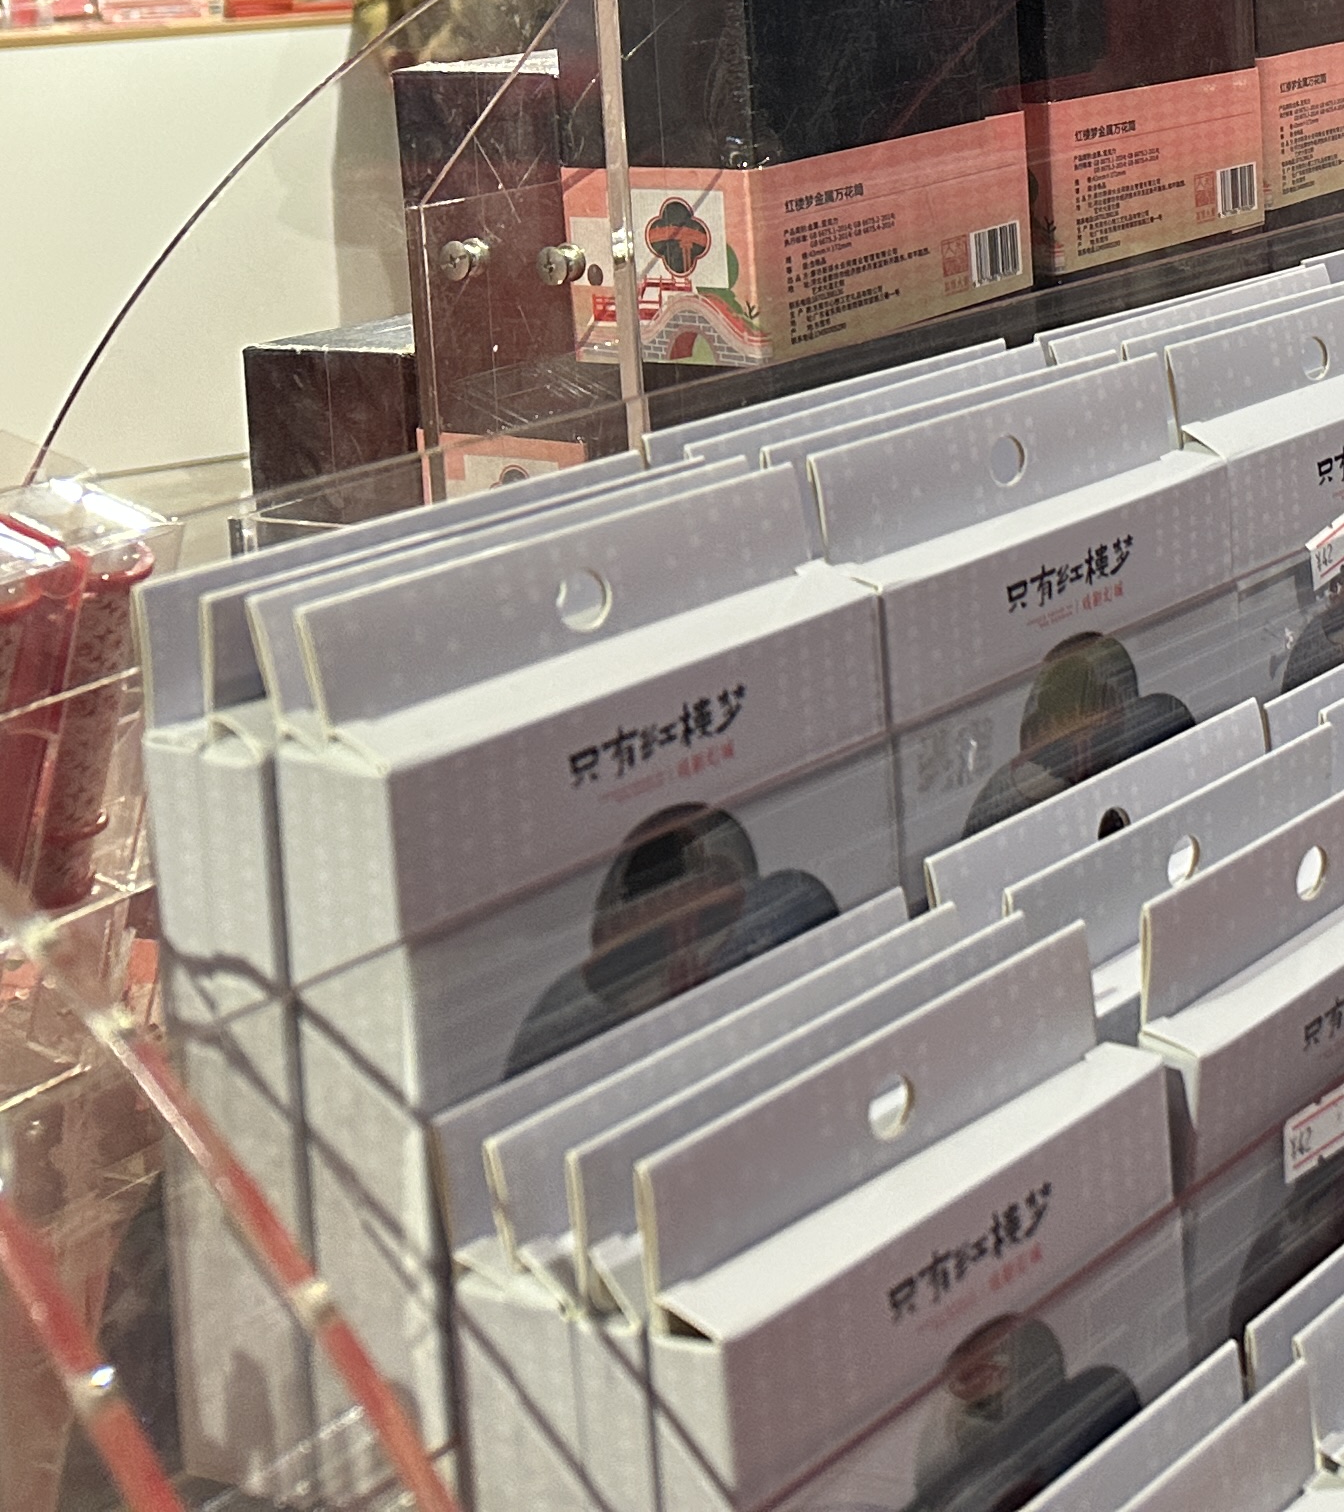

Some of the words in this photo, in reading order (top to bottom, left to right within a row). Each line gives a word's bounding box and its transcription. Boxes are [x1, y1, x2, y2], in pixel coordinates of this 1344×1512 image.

[784, 182, 864, 214] 红楼梦金属万花筒
[1315, 544, 1333, 571] ¥42
